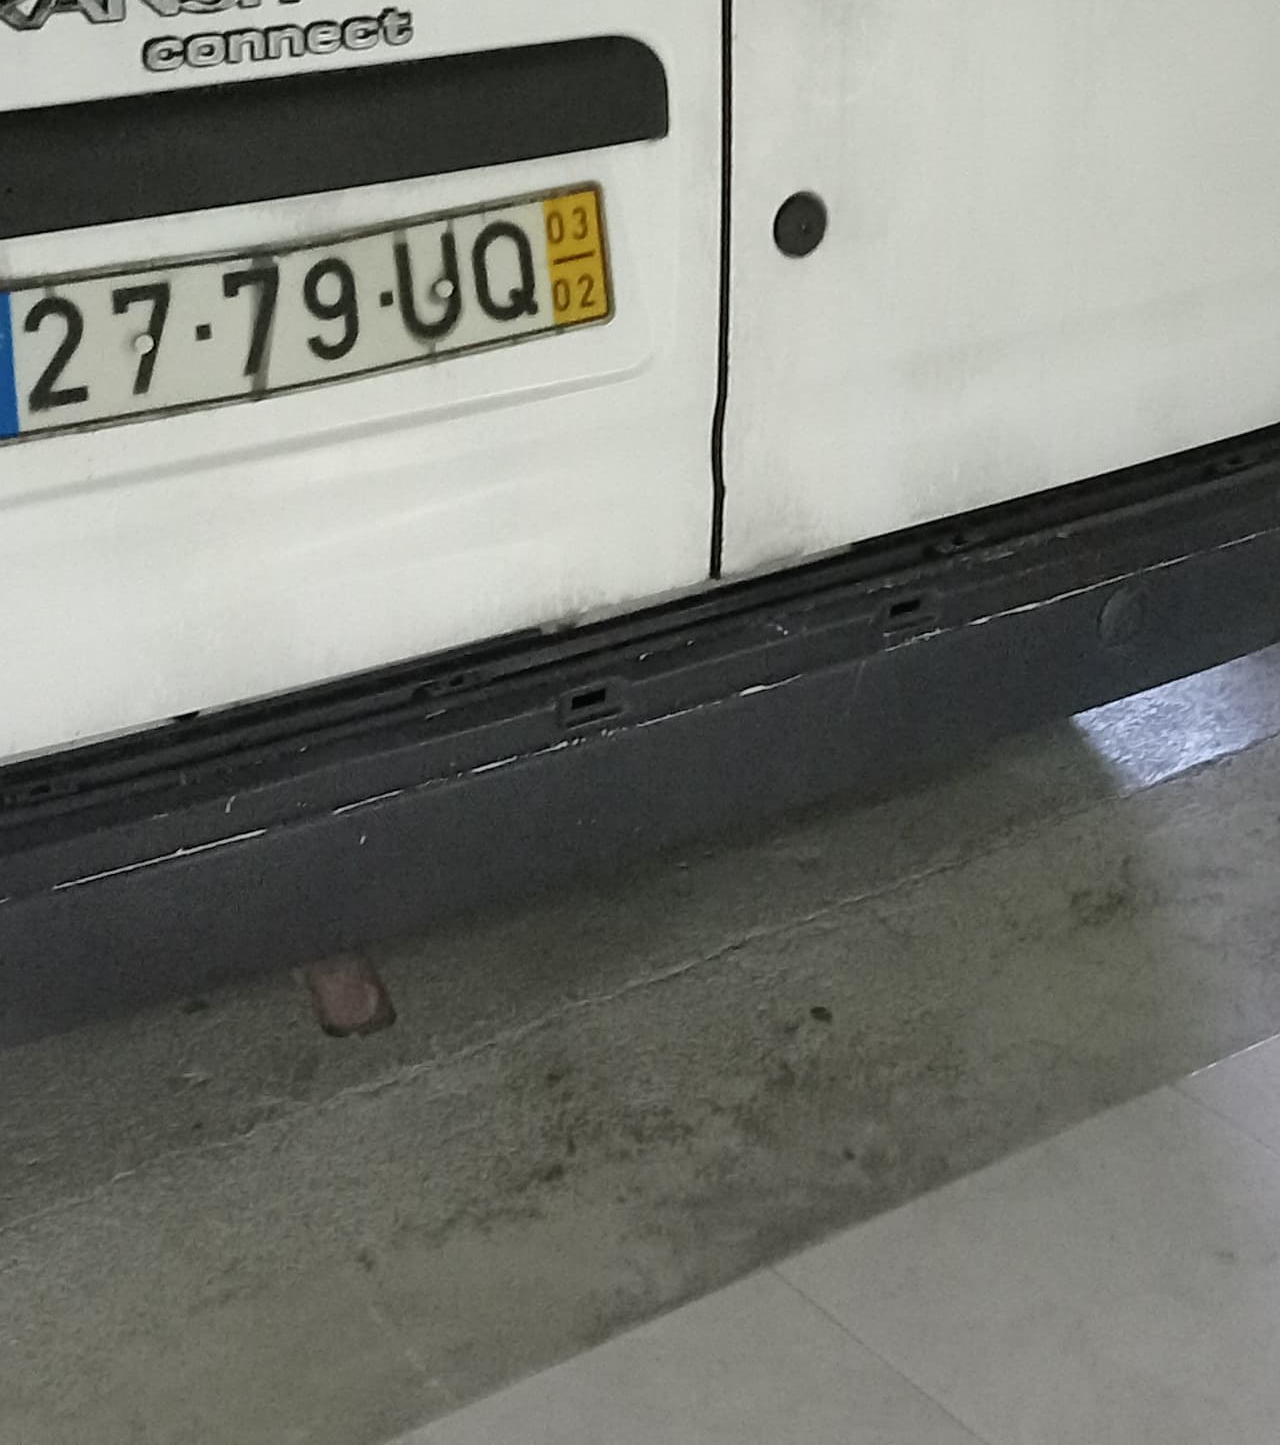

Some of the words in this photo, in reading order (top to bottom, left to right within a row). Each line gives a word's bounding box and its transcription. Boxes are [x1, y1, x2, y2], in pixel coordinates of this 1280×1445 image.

[142, 7, 414, 73] connect
[546, 206, 591, 246] 03
[553, 271, 597, 312] 02
